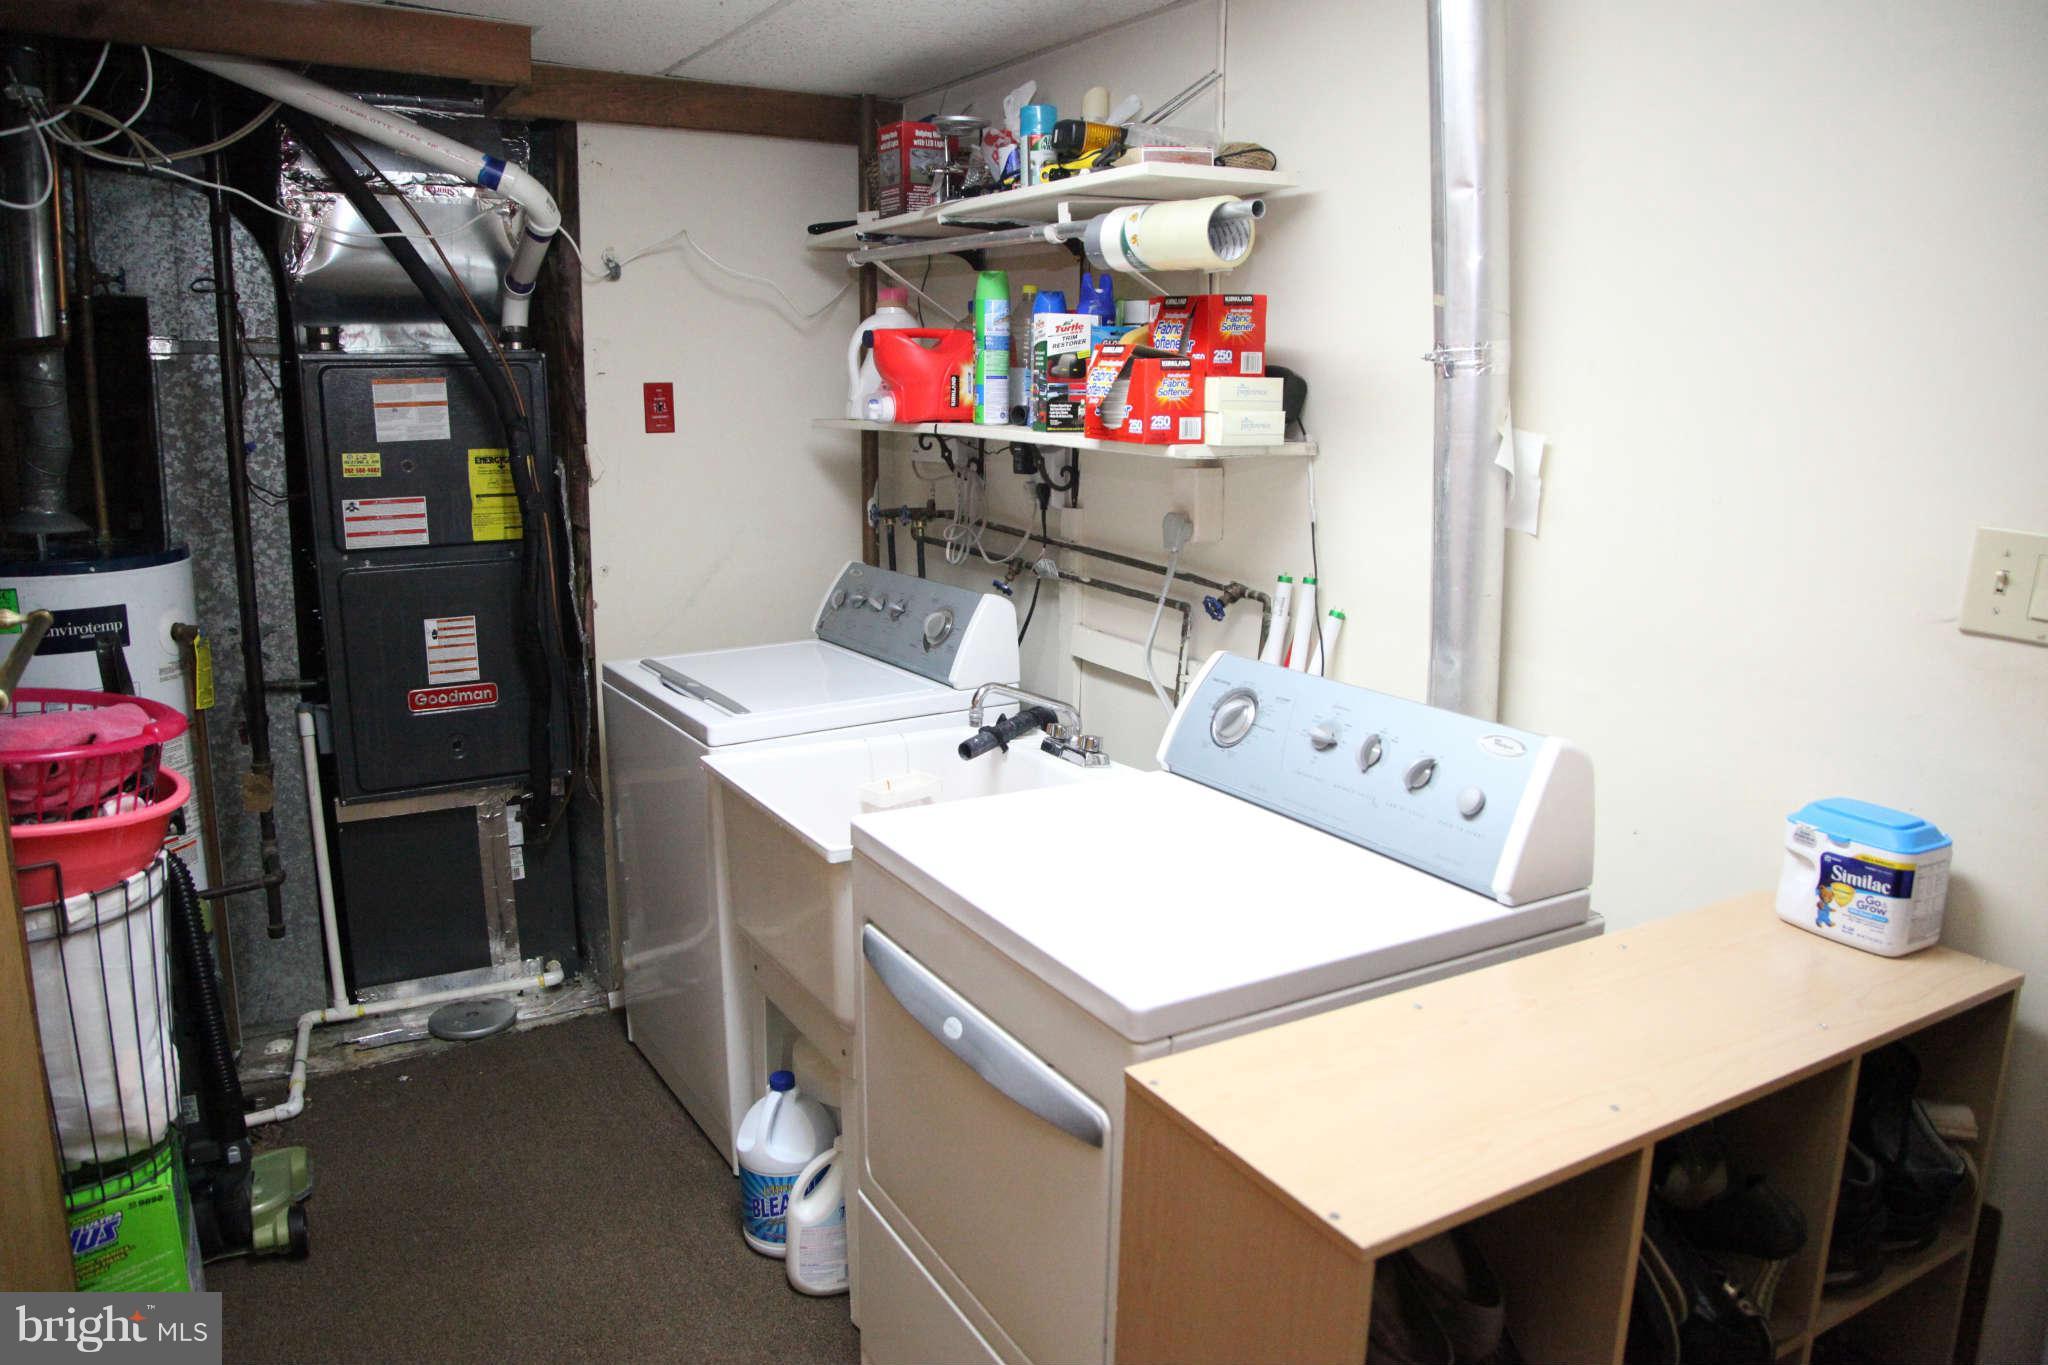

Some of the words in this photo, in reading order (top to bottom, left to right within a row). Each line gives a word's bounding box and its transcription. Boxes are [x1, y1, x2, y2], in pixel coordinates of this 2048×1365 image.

[1225, 313, 1251, 323] Fabric
[1055, 323, 1085, 334] Turtle
[1156, 320, 1183, 335] Fabric
[1221, 322, 1255, 333] Softener
[1052, 339, 1087, 349] RESTORER
[1213, 350, 1233, 361] 250
[1162, 378, 1187, 388] Fabric
[1157, 387, 1192, 398] Softener
[1150, 415, 1171, 426] 250
[46, 620, 122, 638] nvirotemp
[415, 688, 493, 705] Goodman
[1830, 865, 1892, 895] Similac
[1865, 895, 1882, 907] Go
[1856, 899, 1888, 916] Grow
[752, 1193, 789, 1218] BLEA
